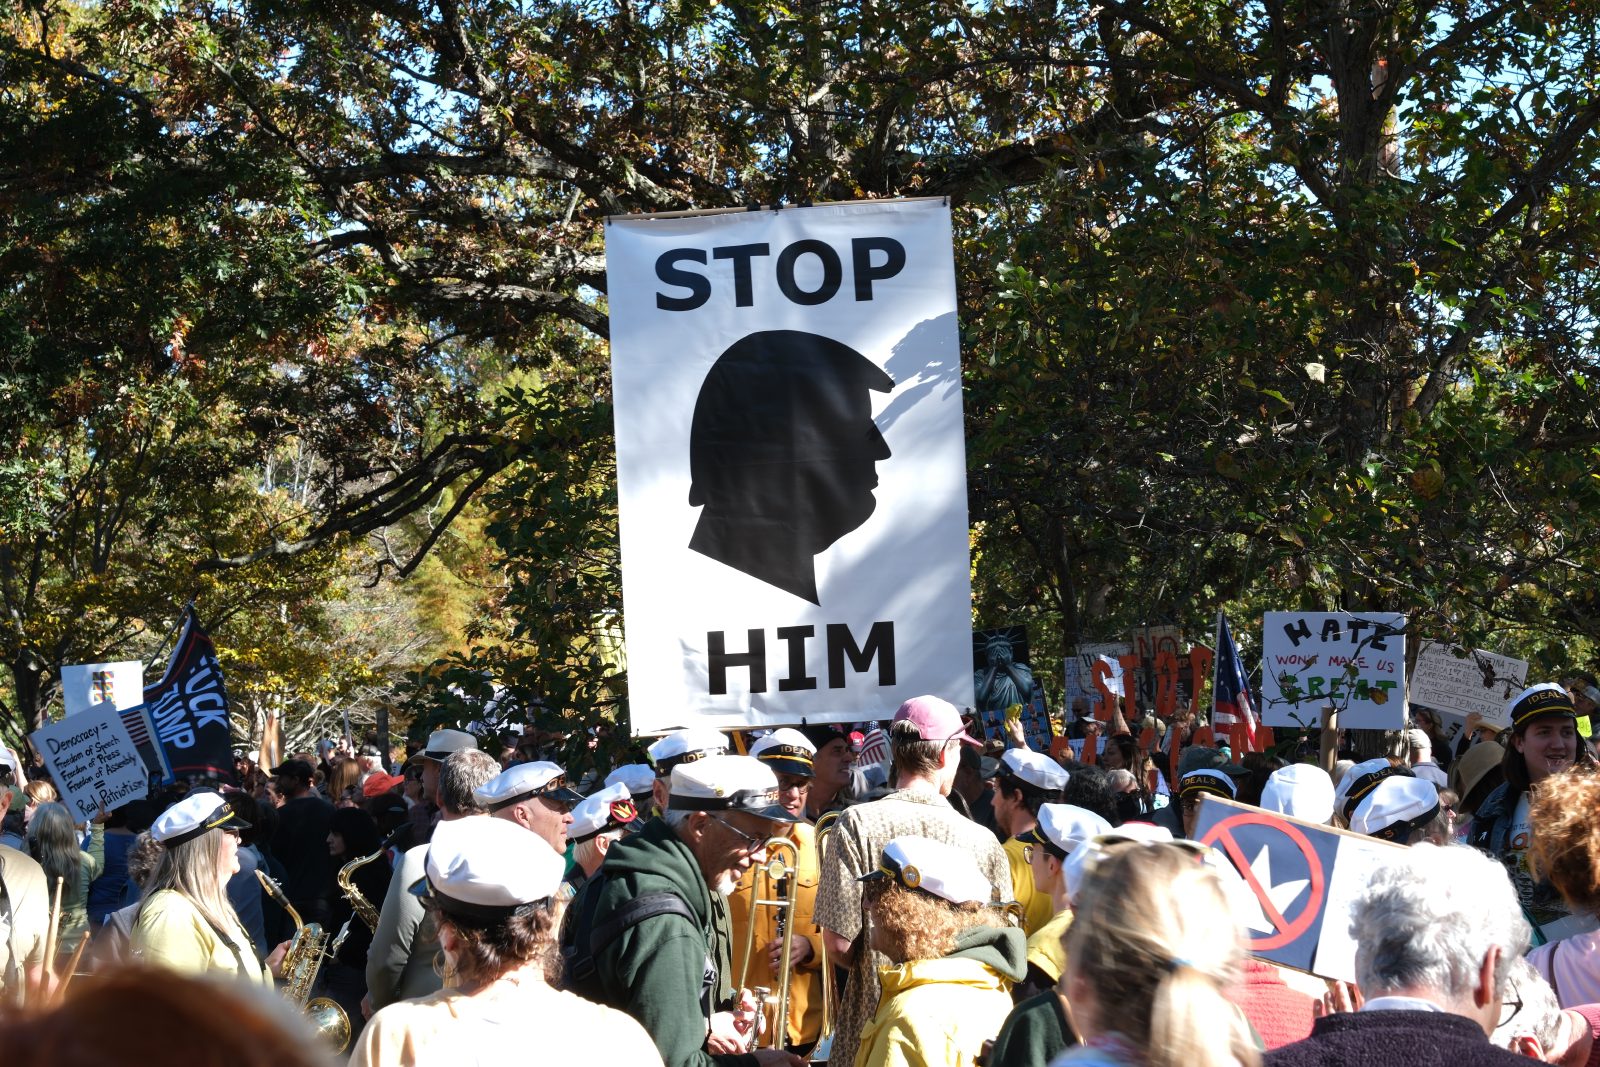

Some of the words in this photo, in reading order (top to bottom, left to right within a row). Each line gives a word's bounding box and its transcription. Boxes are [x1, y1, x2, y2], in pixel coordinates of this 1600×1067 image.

[655, 237, 906, 311] STOP
[1284, 619, 1390, 651] HATE
[707, 621, 896, 695] HIM
[1377, 659, 1394, 673] US
[185, 655, 229, 729] UCK
[1416, 687, 1453, 702] PROTECT
[1454, 696, 1504, 717] DEMOCRACY
[152, 683, 196, 748] UMP
[46, 726, 100, 755] Democracy
[53, 752, 84, 771] Freedom
[85, 745, 93, 757] of
[95, 734, 121, 755] Speech
[60, 765, 87, 782] Freedom
[89, 758, 96, 768] of
[97, 749, 121, 765] Press
[66, 775, 94, 793] Freedom
[95, 767, 104, 779] of
[106, 752, 137, 776] Assembly
[76, 795, 99, 817] Real
[99, 780, 146, 807] Patriotism
